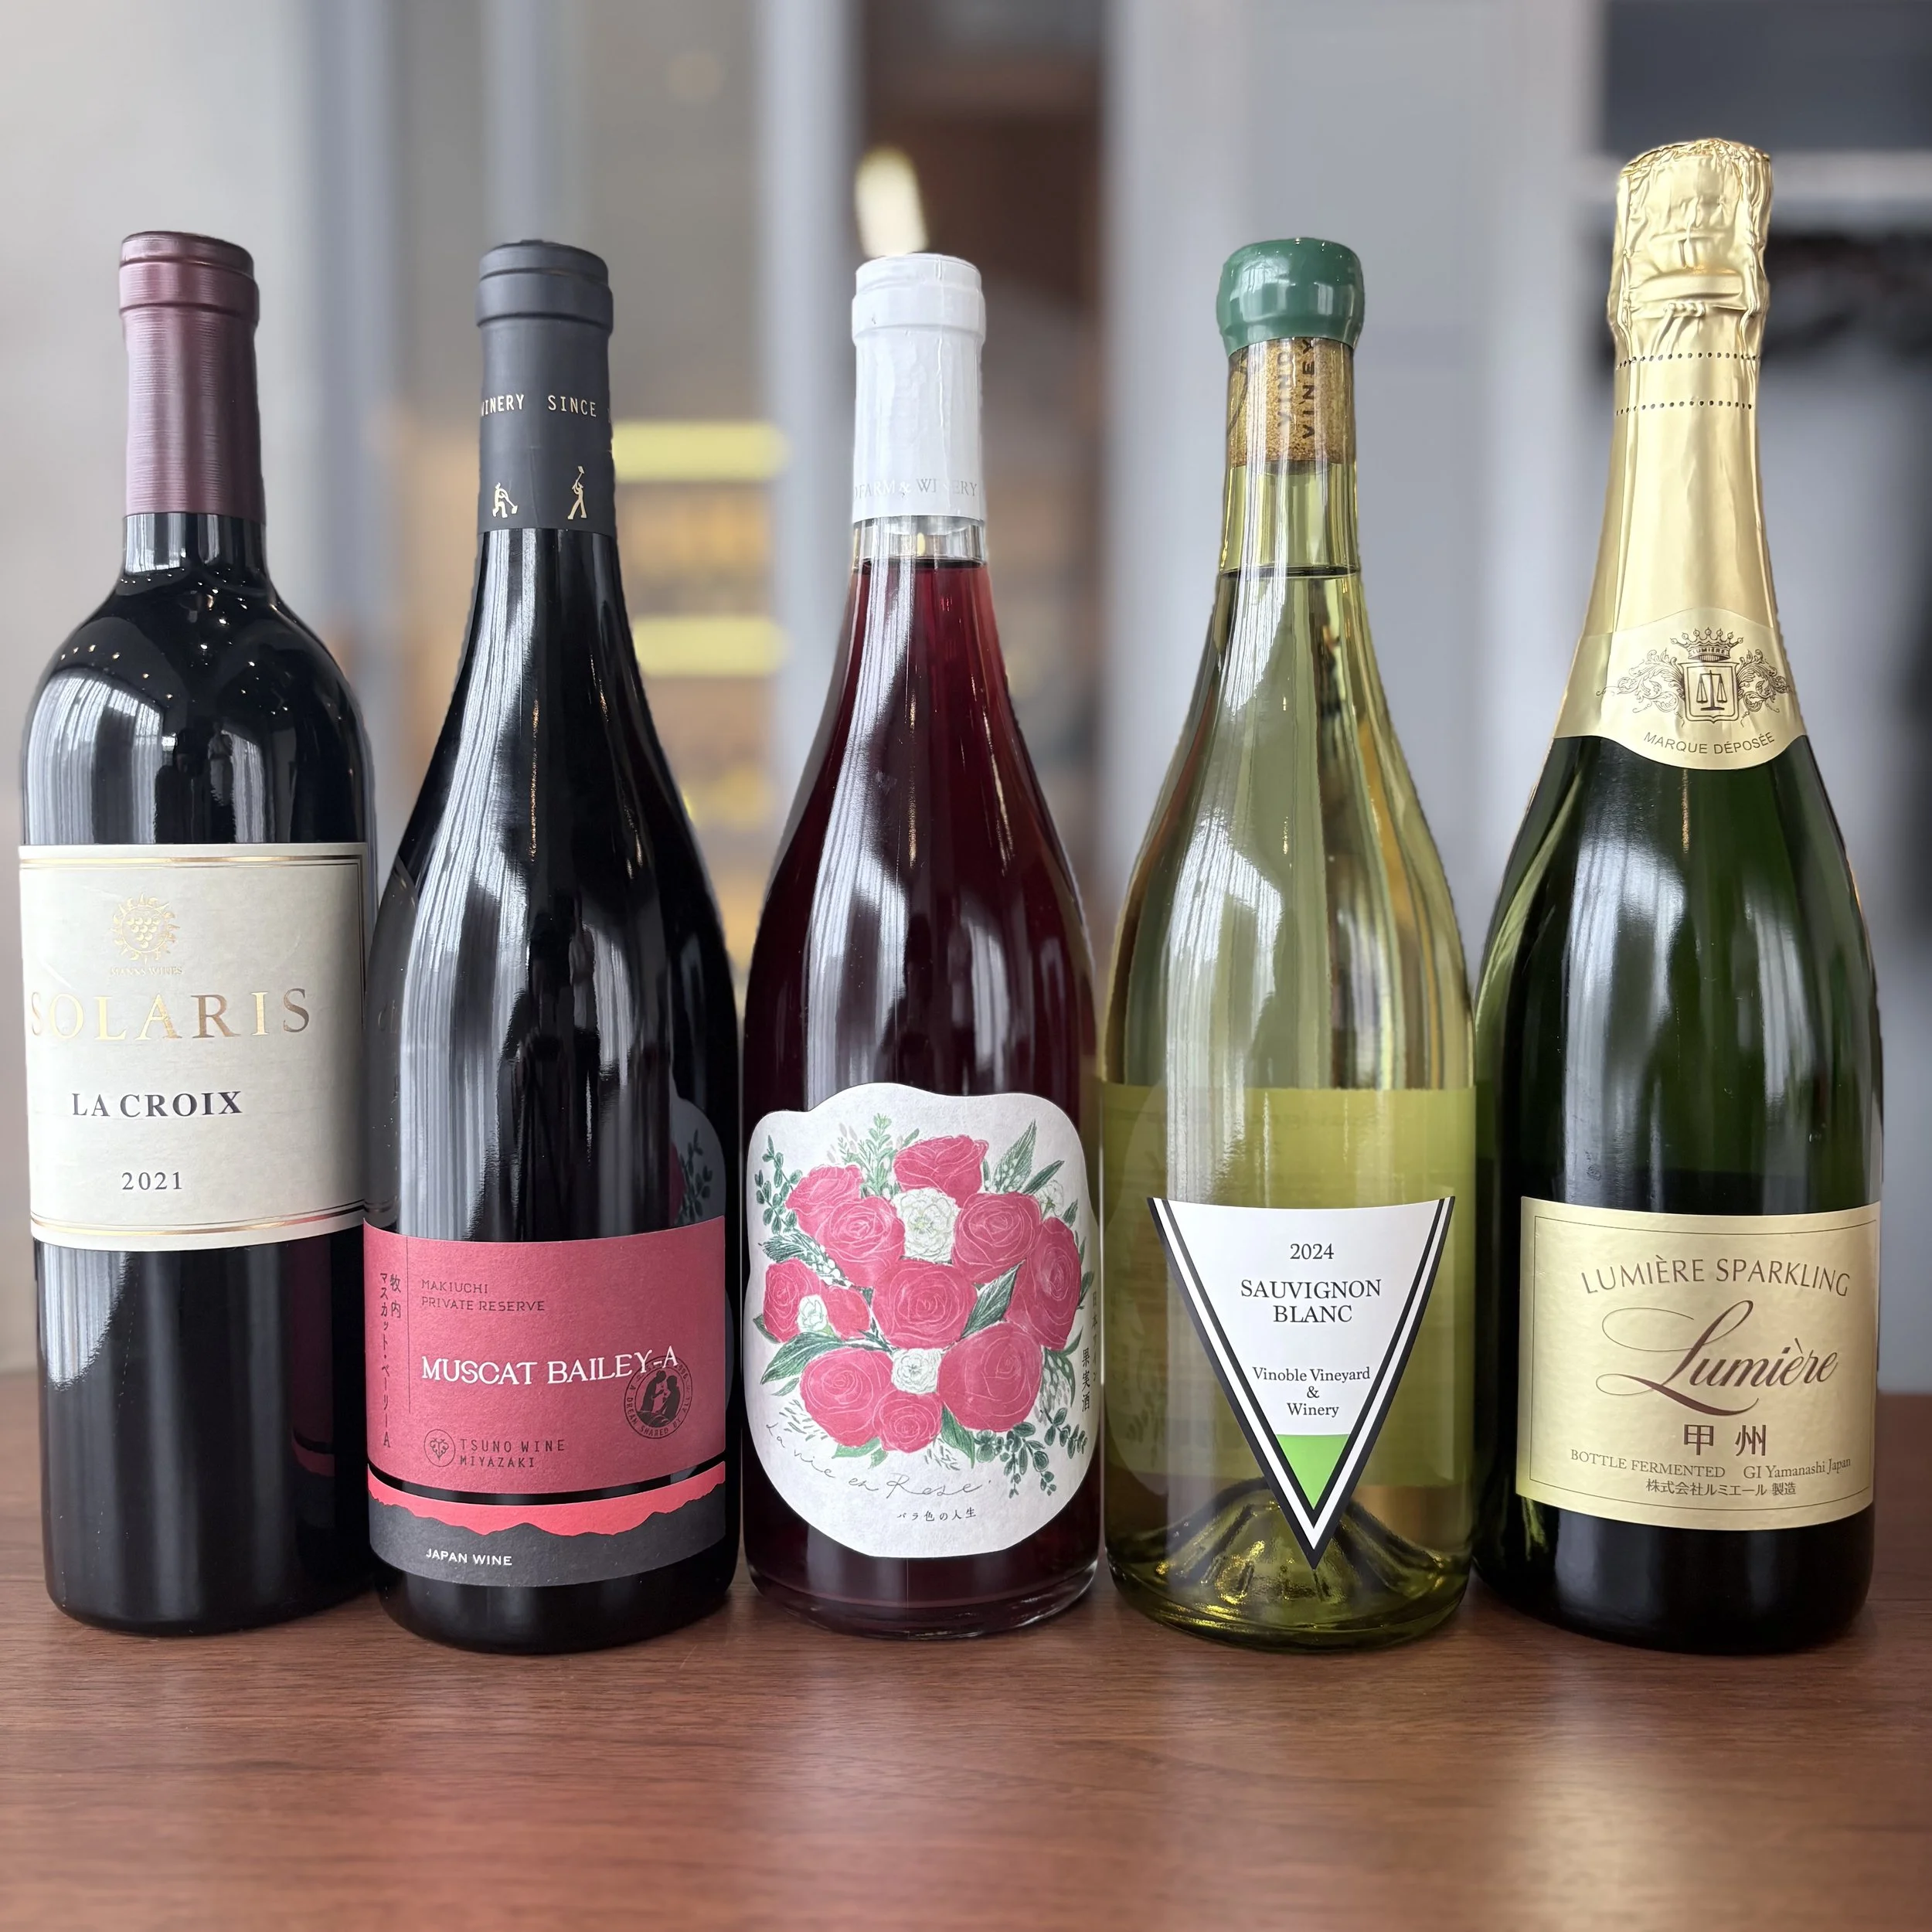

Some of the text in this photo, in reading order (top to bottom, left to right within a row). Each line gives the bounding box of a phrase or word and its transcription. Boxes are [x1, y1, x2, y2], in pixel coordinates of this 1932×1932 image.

[547, 395, 597, 417] SINCE
[1644, 732, 1776, 754] MARQUE DÉPOSÉE
[31, 988, 310, 1041] SOLARIS
[73, 1090, 243, 1118] LA CROIX
[121, 1171, 183, 1190] 2021
[1289, 1243, 1335, 1261] 2024
[1581, 1255, 1850, 1297] LUMIÈRE SPARKLING
[389, 1274, 401, 1318] 牧内
[421, 1280, 488, 1294] MAKIUCHI
[1240, 1279, 1382, 1300] SAUVIGNON
[421, 1296, 545, 1311] PRIVATE RESERVE
[1273, 1304, 1353, 1324] BLANC
[421, 1356, 538, 1385] MUSCAT
[547, 1345, 679, 1385] BAILEY-A
[1596, 1300, 1839, 1416] Lumière
[1082, 1347, 1090, 1413] 果実酒
[1252, 1366, 1371, 1385] Vinoble Vineyard
[1306, 1386, 1320, 1400] &
[1287, 1403, 1339, 1419] Winery
[640, 1425, 669, 1437] SHARED
[1683, 1423, 1767, 1458] 甲州
[460, 1439, 566, 1453] TSUNO WINE
[460, 1455, 535, 1468] MIYAZAKI
[1570, 1448, 1852, 1479] BOTTLE FERMENTED GI Yamanashi Japan
[1646, 1478, 1797, 1496] 株式会社ルミエール 製造
[897, 1507, 977, 1522] バラ色の人生
[425, 1548, 513, 1566] JAPAN WINE
